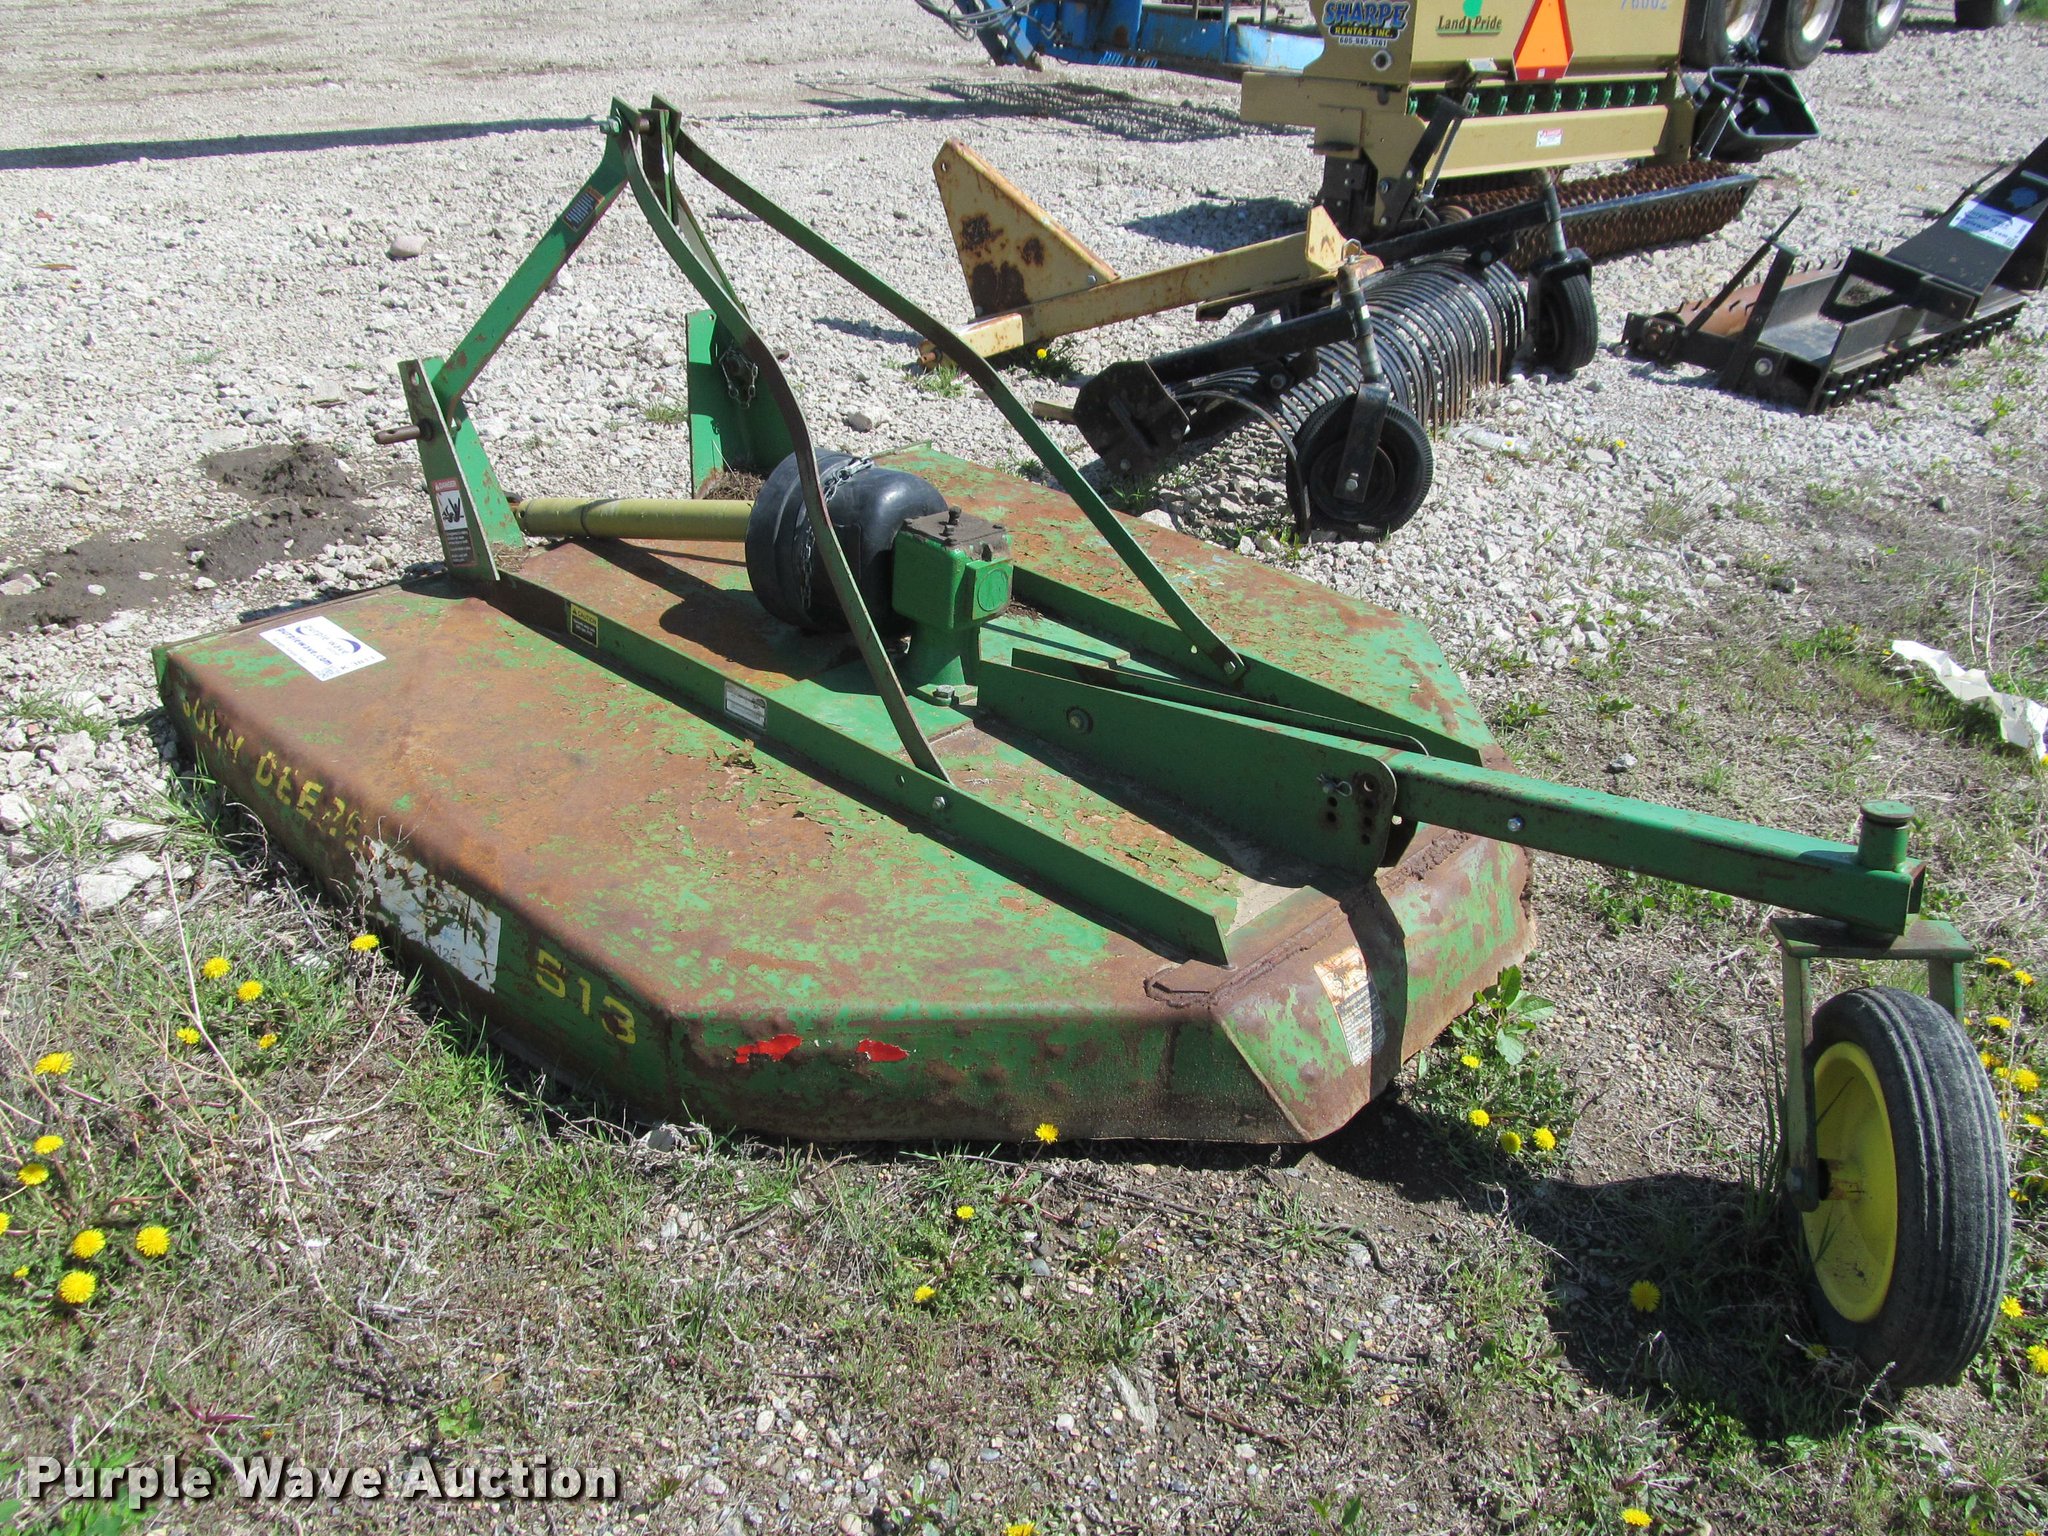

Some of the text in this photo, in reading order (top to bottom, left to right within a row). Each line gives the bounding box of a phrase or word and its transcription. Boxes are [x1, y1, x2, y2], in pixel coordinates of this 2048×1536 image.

[1324, 1, 1409, 29] SHARPE
[1438, 15, 1502, 30] Land Pride
[1335, 26, 1374, 36] RENTALS
[536, 949, 636, 1045] 513
